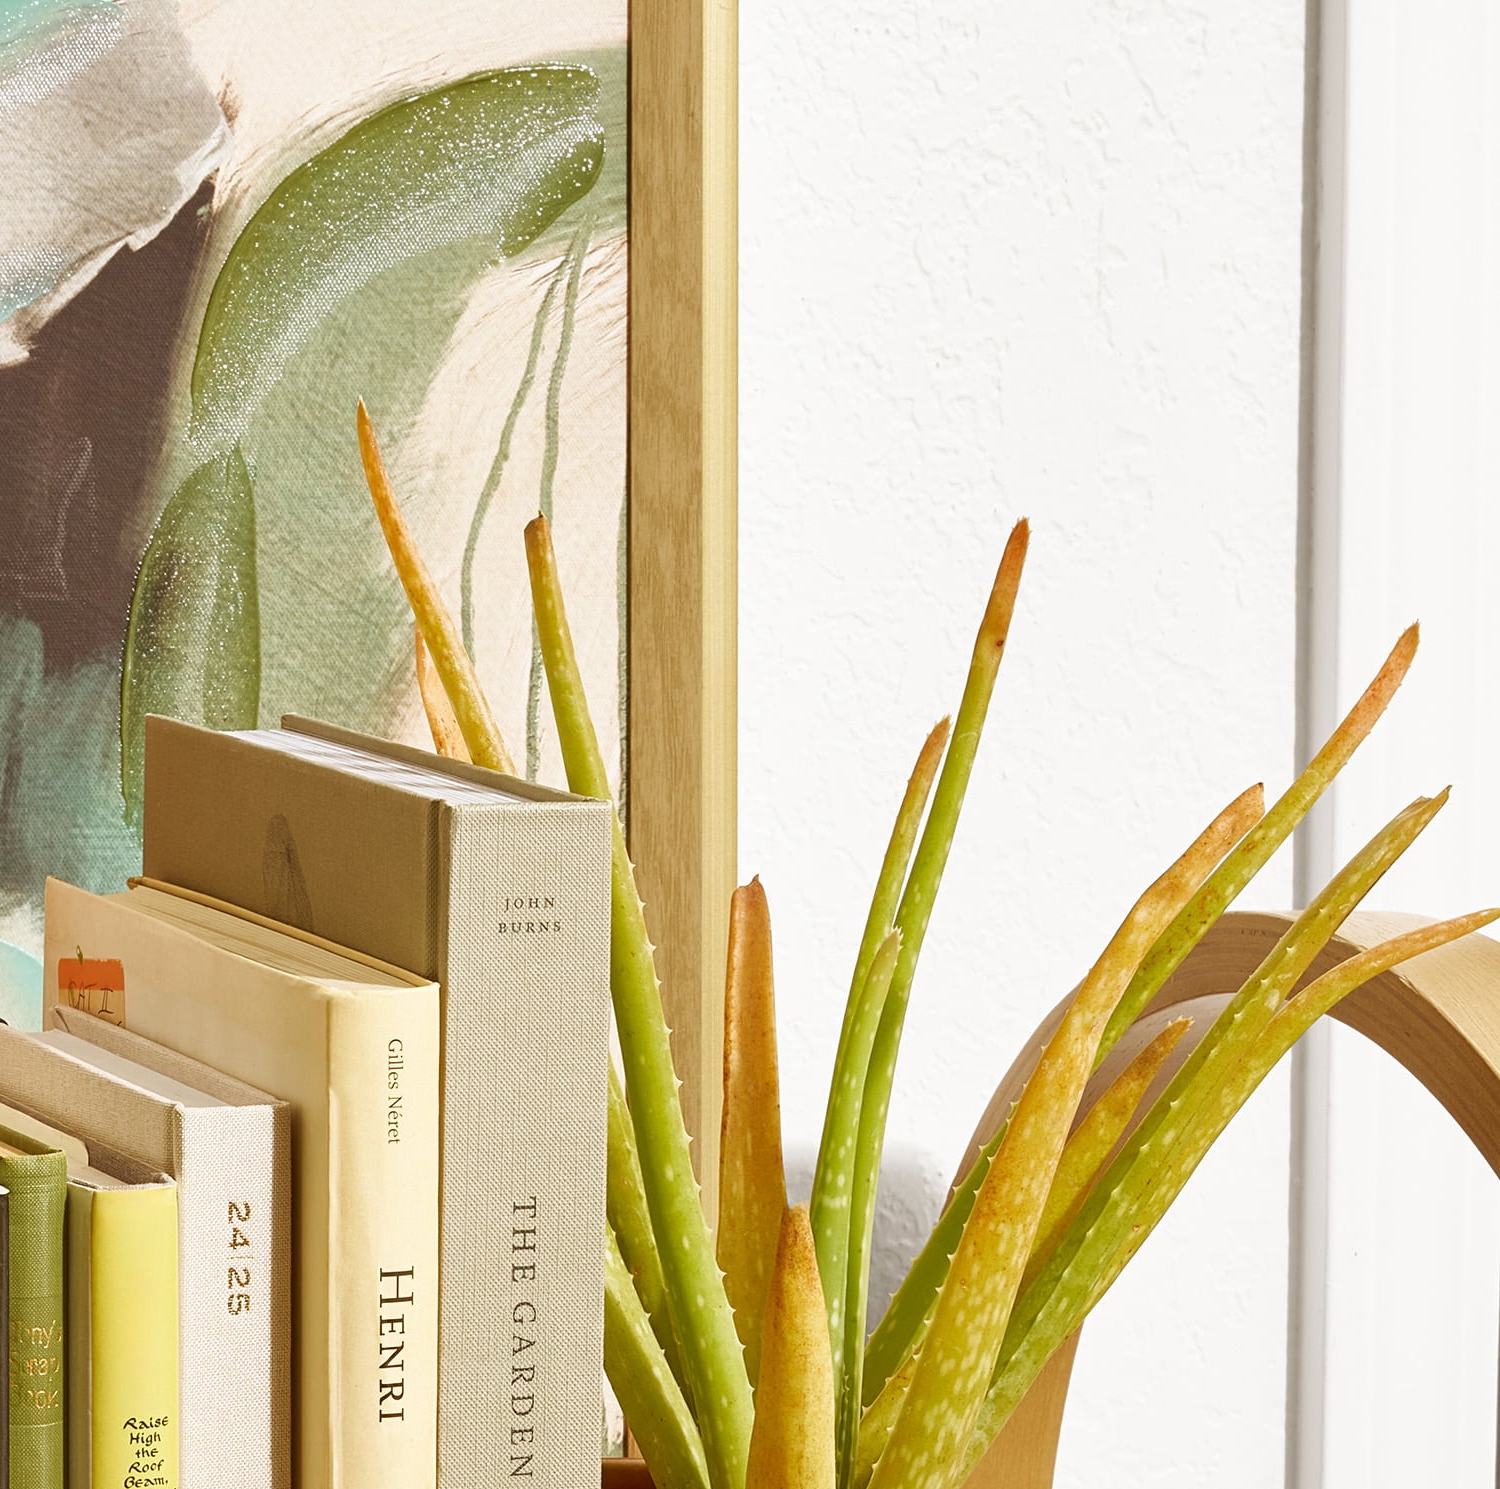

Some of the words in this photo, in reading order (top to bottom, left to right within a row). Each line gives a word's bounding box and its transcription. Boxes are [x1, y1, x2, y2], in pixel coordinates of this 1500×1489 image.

[503, 897, 554, 913] JOHN
[498, 921, 561, 934] BURNS
[387, 1038, 404, 1090] Gilles
[386, 1095, 402, 1145] Néret
[510, 1196, 539, 1281] THE
[378, 1266, 414, 1422] HENRI
[509, 1301, 538, 1478] GARDEN
[123, 1416, 168, 1430] Raise
[130, 1432, 161, 1446] High
[135, 1448, 159, 1458] the
[128, 1459, 164, 1473] Roof
